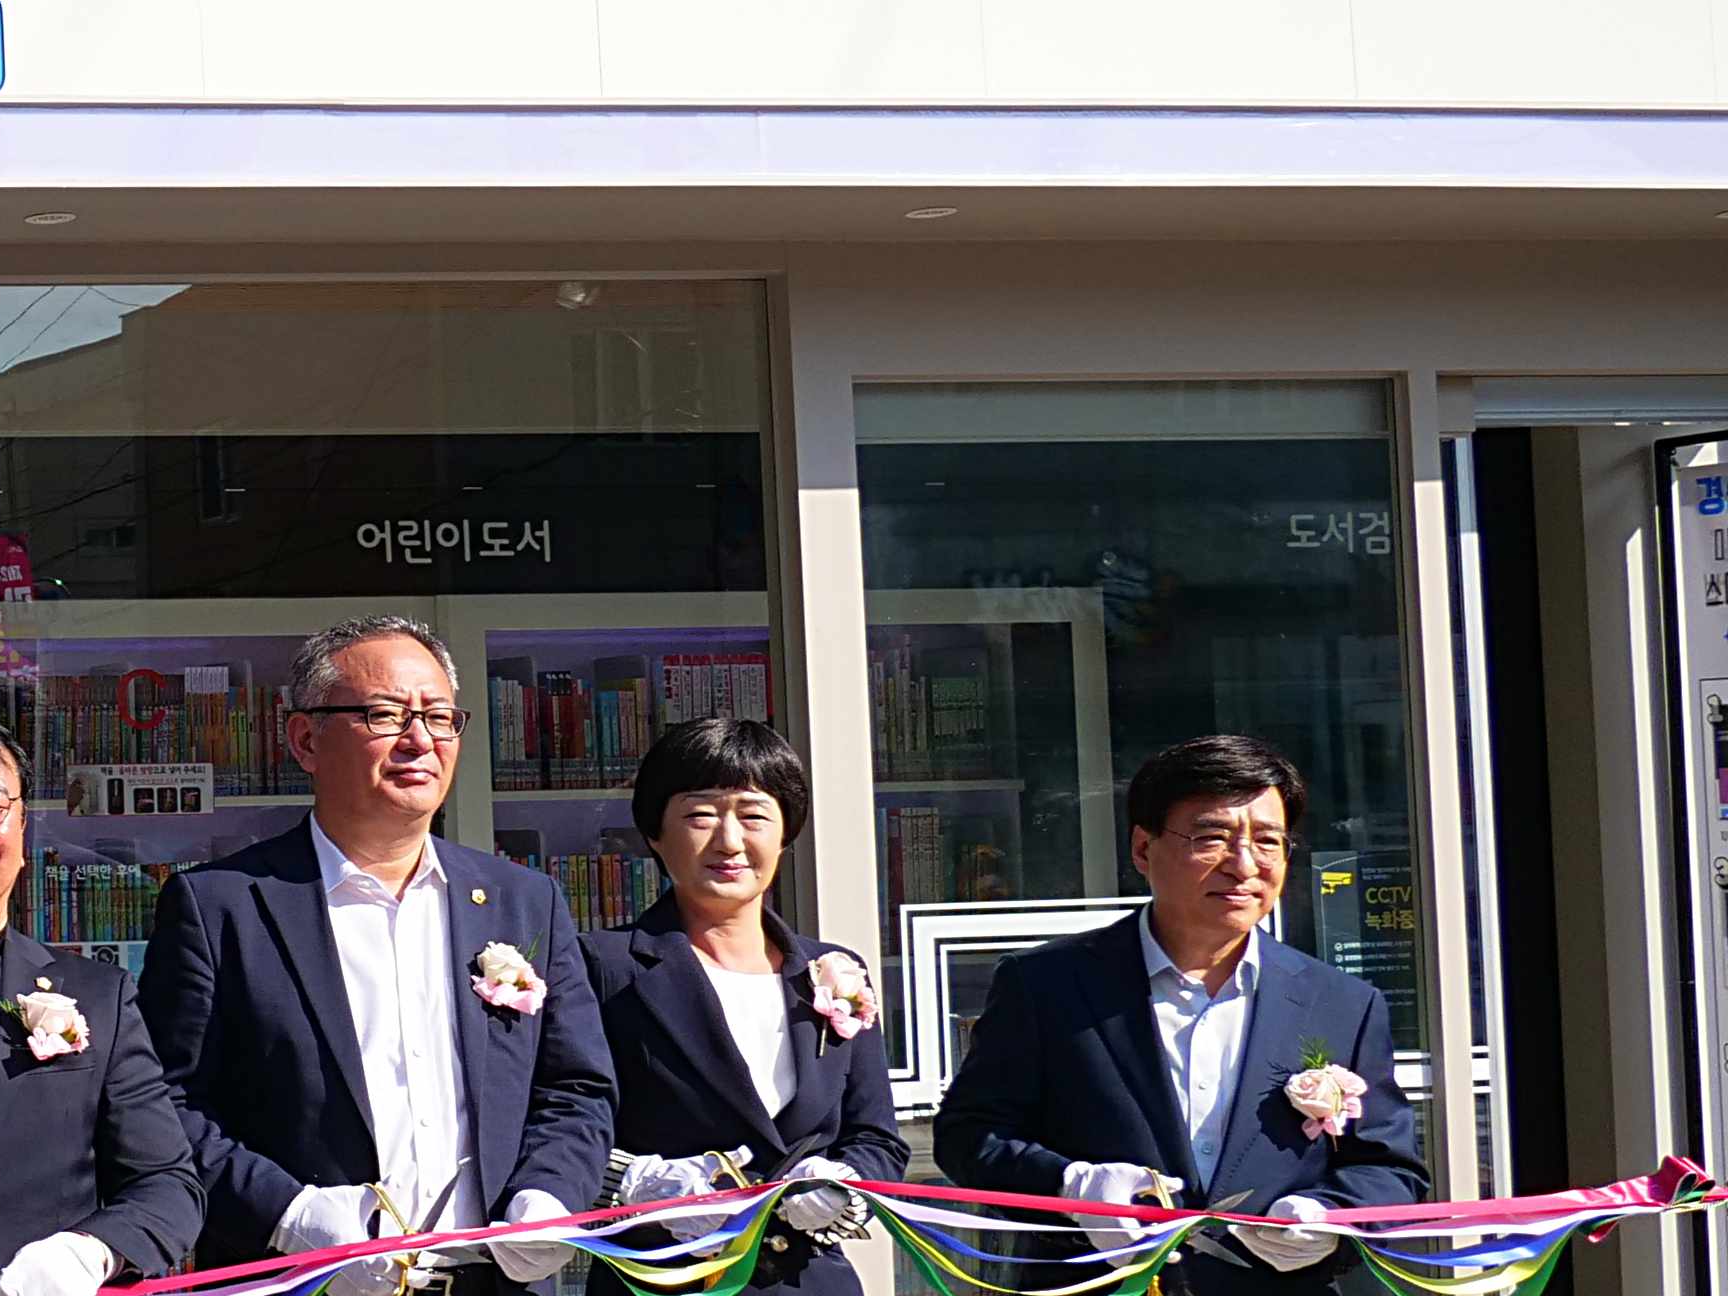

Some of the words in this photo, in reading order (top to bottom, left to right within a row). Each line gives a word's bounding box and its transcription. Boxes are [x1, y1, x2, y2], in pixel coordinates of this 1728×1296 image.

[117, 669, 168, 730] C
[74, 863, 112, 881] 선택한
[1365, 886, 1412, 904] CCTV
